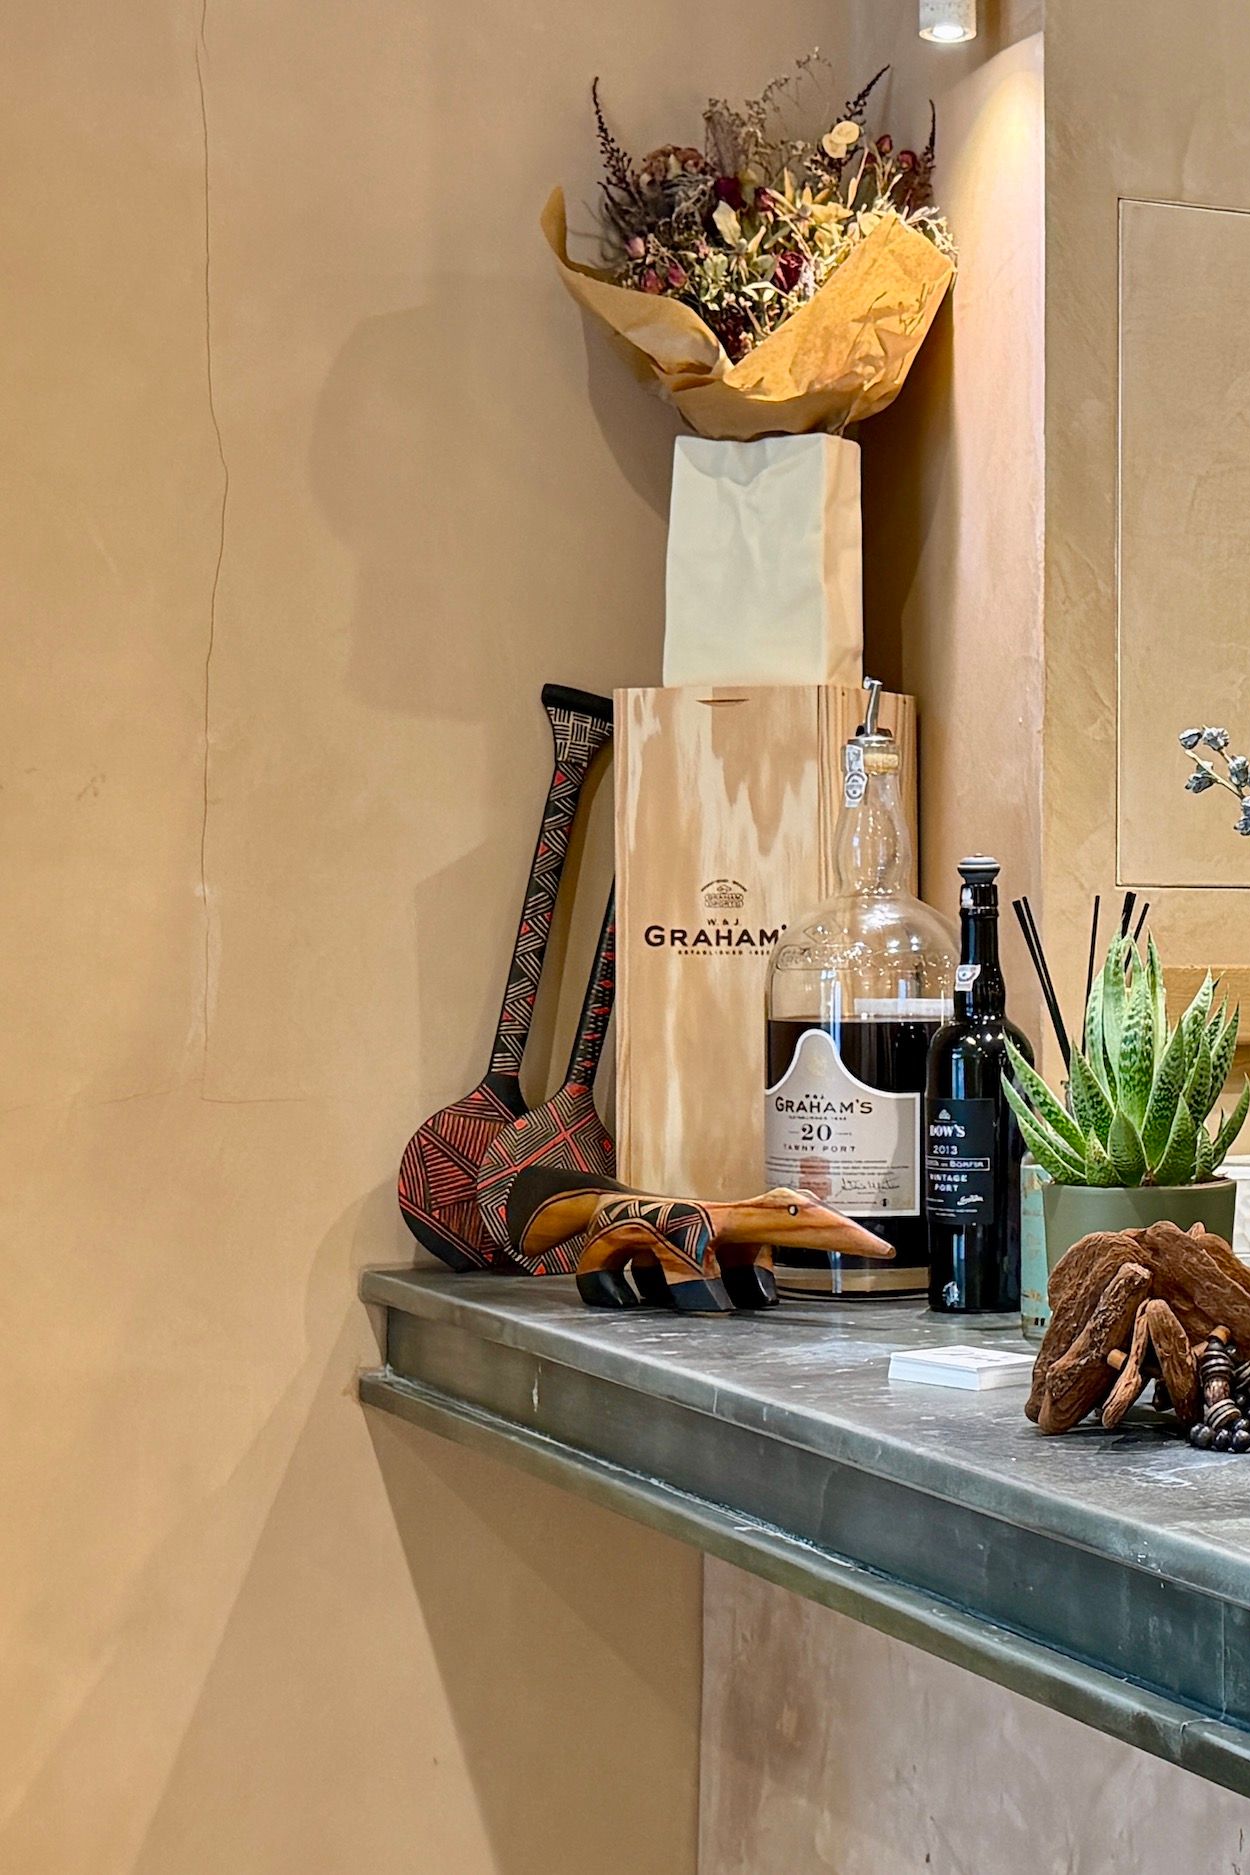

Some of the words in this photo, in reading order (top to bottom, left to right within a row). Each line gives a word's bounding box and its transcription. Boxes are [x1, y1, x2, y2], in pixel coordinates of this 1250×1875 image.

[644, 924, 787, 947] GRAHAM'
[775, 1096, 873, 1114] GRAHAM'S
[801, 1123, 832, 1141] 20
[933, 1145, 958, 1155] 2013
[929, 1174, 968, 1182] VINTAGE
[934, 1184, 959, 1192] PORT
